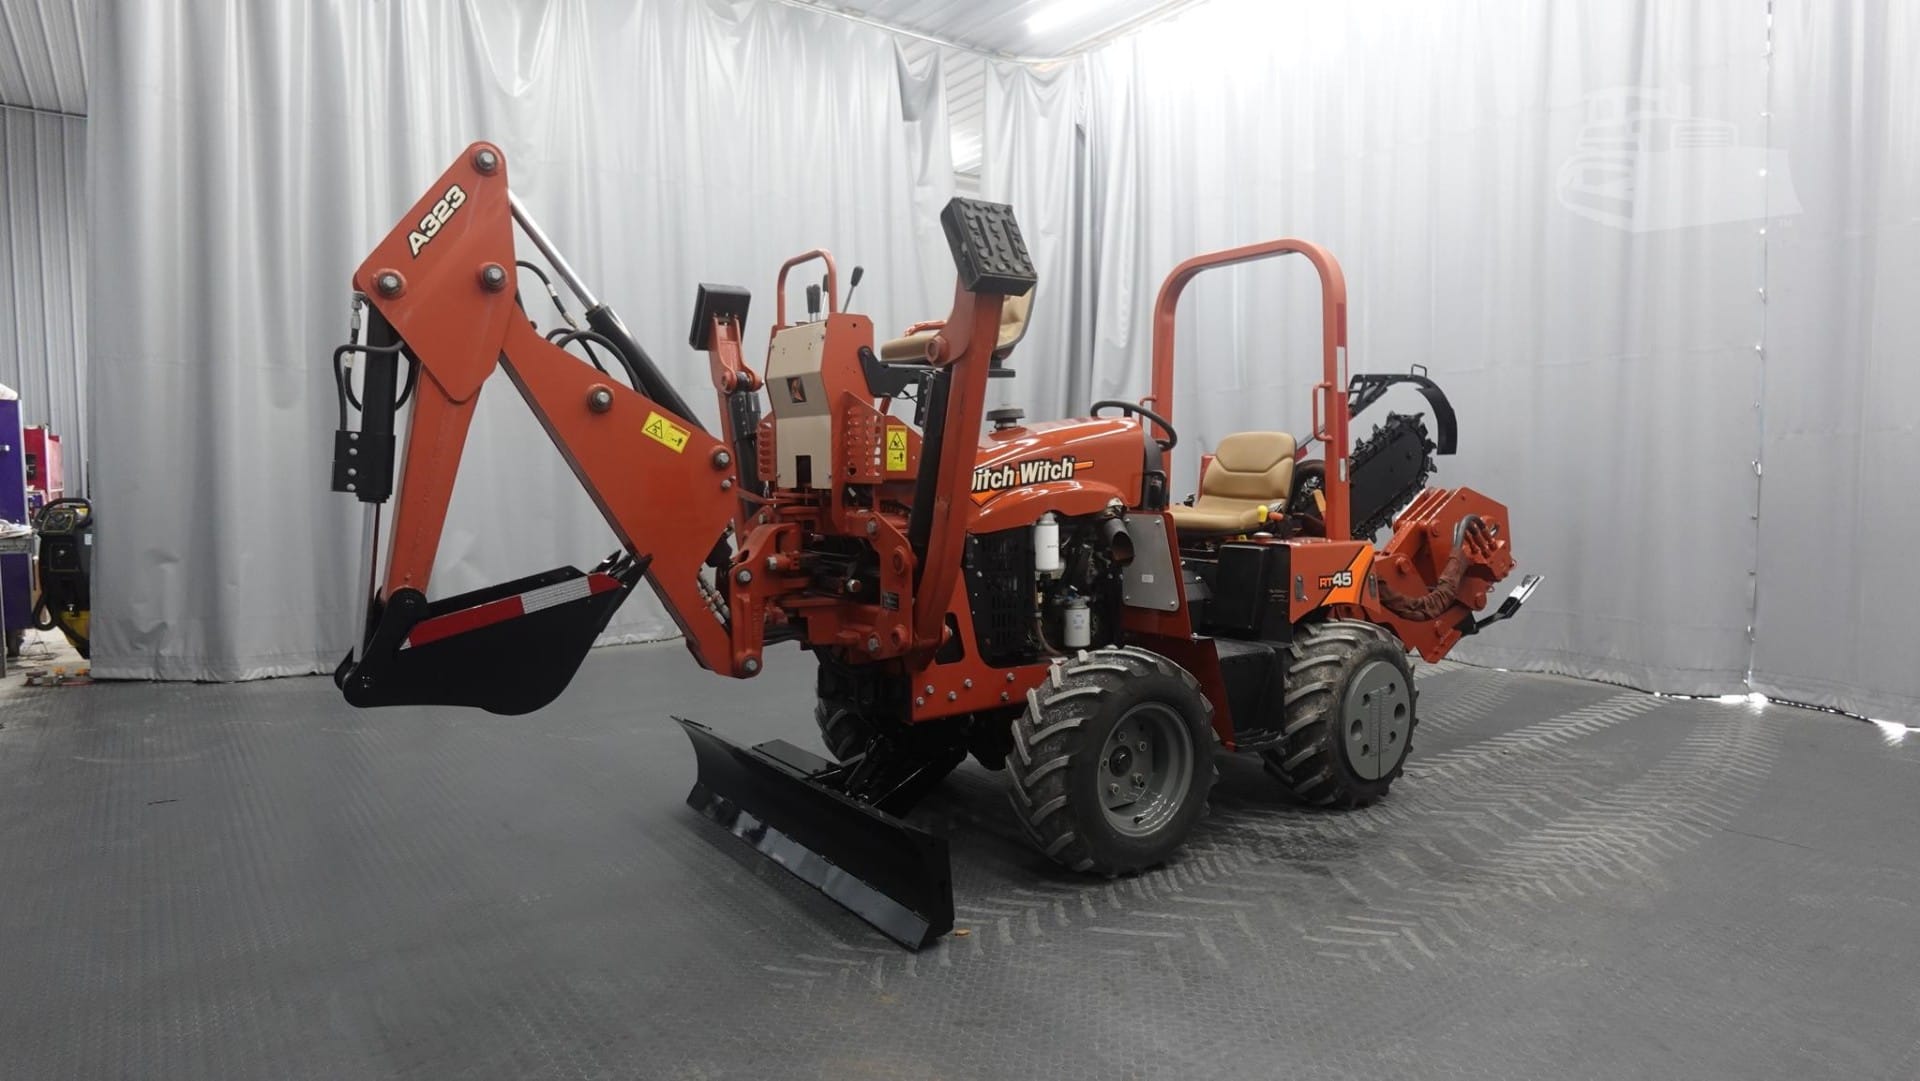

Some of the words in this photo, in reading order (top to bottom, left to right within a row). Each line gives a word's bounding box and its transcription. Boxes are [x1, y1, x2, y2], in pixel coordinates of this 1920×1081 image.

[408, 185, 467, 257] A323
[1020, 457, 1074, 484] Witch
[1319, 572, 1352, 588] RT45
